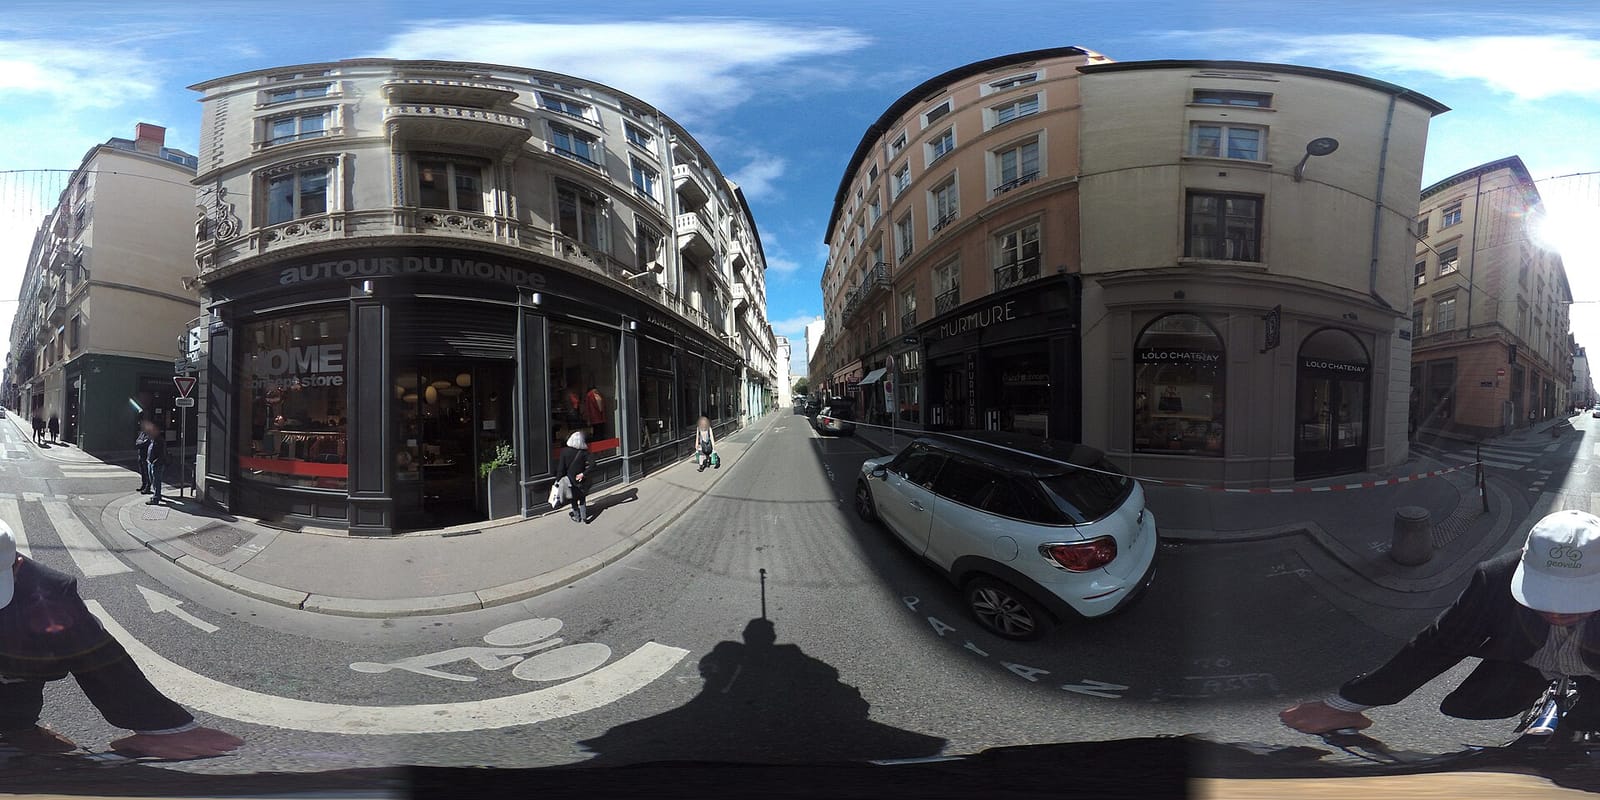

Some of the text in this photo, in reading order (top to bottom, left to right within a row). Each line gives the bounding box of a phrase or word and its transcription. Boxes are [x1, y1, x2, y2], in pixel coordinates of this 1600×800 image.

[403, 256, 444, 274] DU
[940, 300, 1017, 338] MURMURE
[1141, 351, 1220, 362] LOLO CHATENAY
[1305, 361, 1366, 373] LOLO CHATENAY
[302, 374, 344, 388] store
